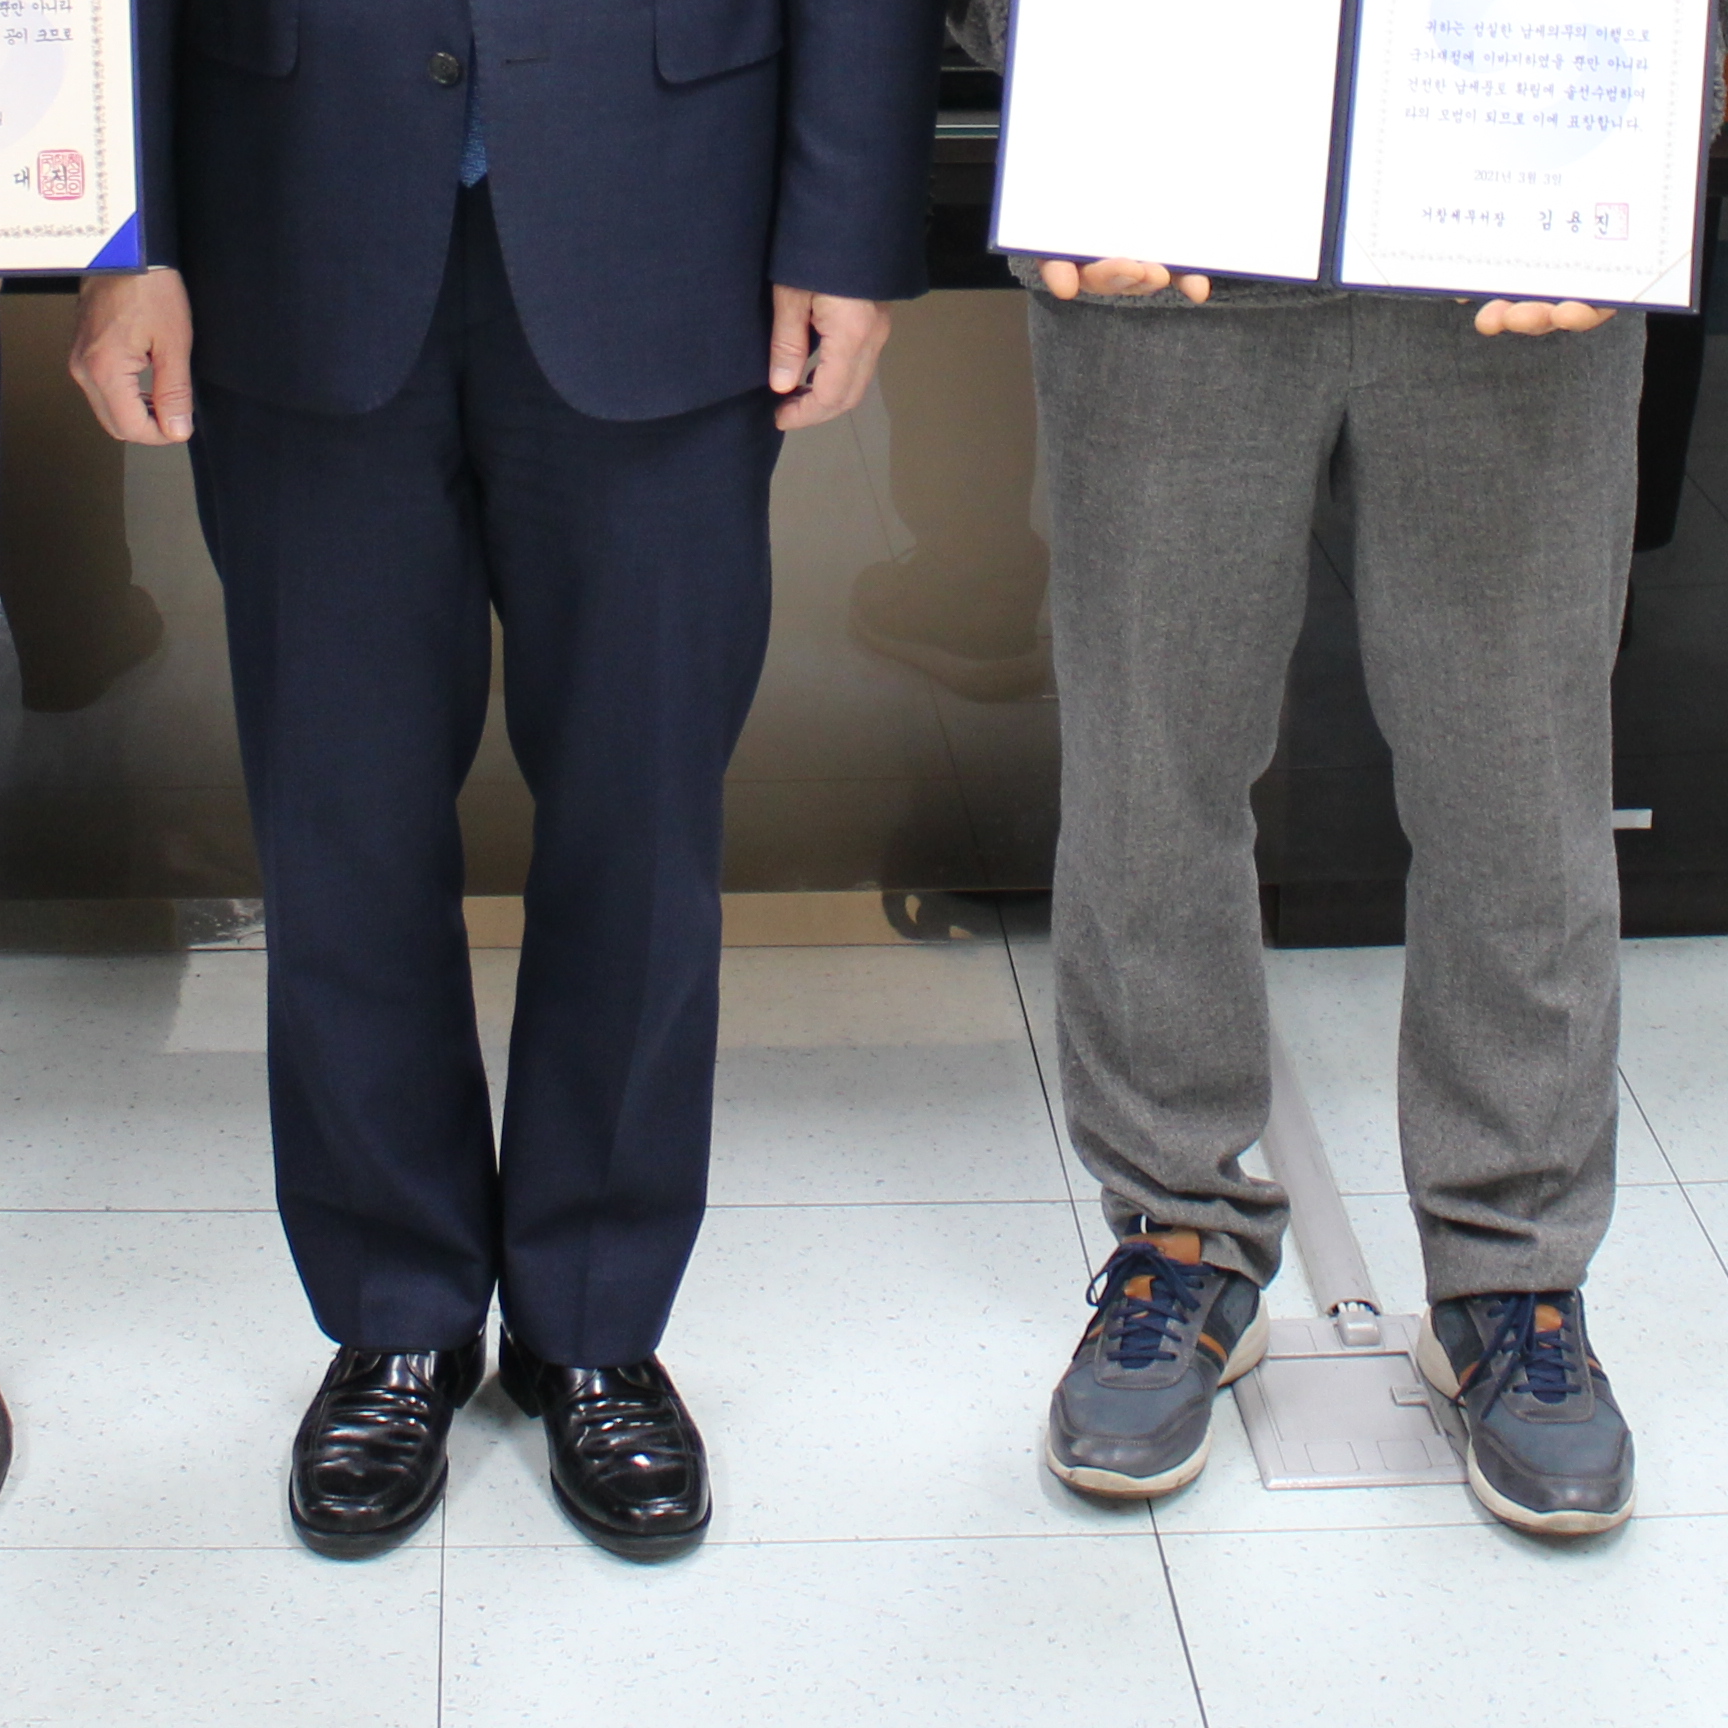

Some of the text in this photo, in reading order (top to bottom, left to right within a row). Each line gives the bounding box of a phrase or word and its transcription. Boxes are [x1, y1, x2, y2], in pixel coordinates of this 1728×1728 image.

[3, 27, 28, 46] 공이
[34, 27, 74, 43] 크므로
[1425, 18, 1651, 44] 귀하는 성실한 납세의무의 이행으로
[1410, 47, 1648, 72] 국가재정에 이바지하였을 뿐만 아니라
[1407, 76, 1447, 94] 건전한
[1454, 79, 1507, 98] 납세풍토
[1515, 81, 1555, 99] 확립에
[1437, 108, 1477, 124] 모범이
[1485, 109, 1525, 126] 되므로
[1532, 111, 1559, 128] 이에
[1474, 169, 1562, 186] 2021년 3월 3일
[1422, 206, 1506, 228] 거창세무서장
[1539, 208, 1610, 236] 김용진
